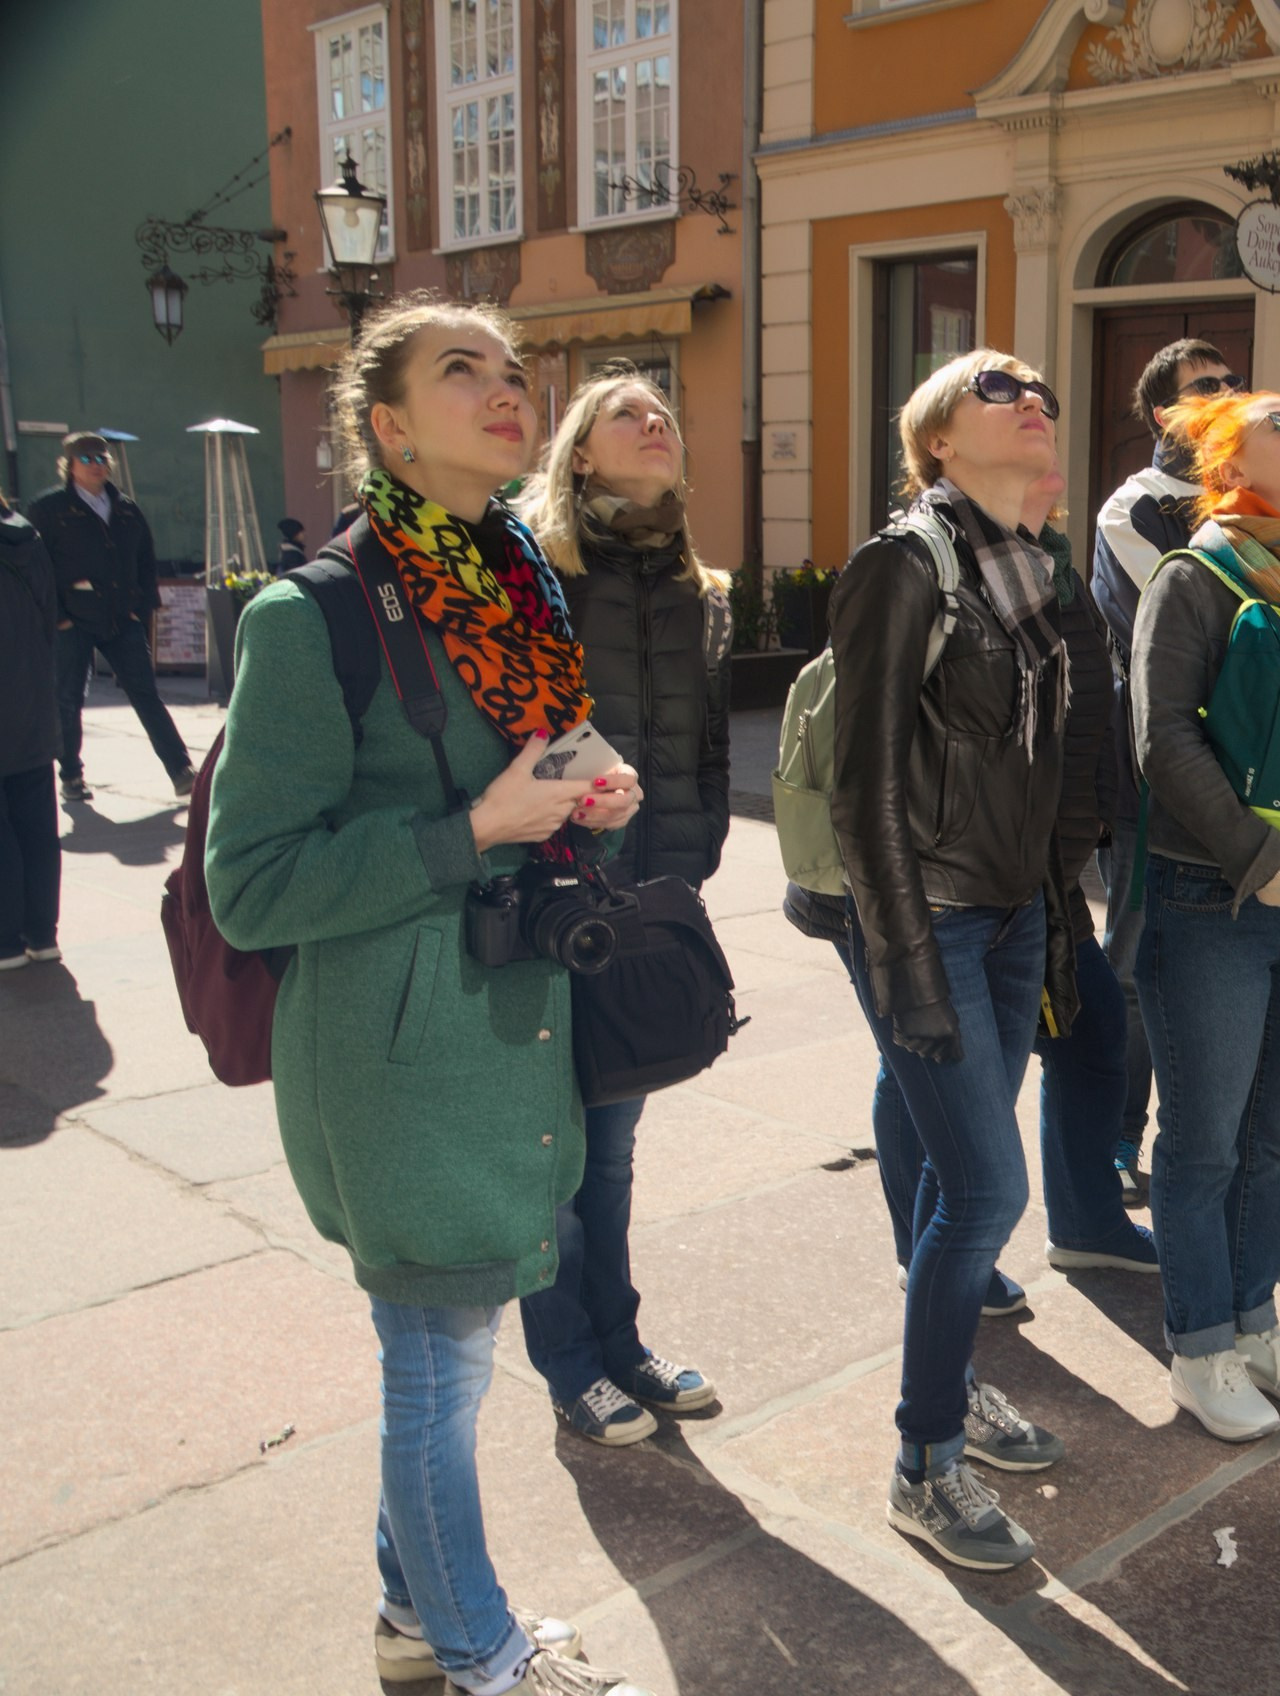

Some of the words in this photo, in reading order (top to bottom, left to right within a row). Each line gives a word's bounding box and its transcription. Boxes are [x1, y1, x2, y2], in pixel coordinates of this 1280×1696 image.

[1247, 230, 1275, 253] Dom
[377, 582, 404, 623] EOS
[554, 877, 579, 888] Canon
